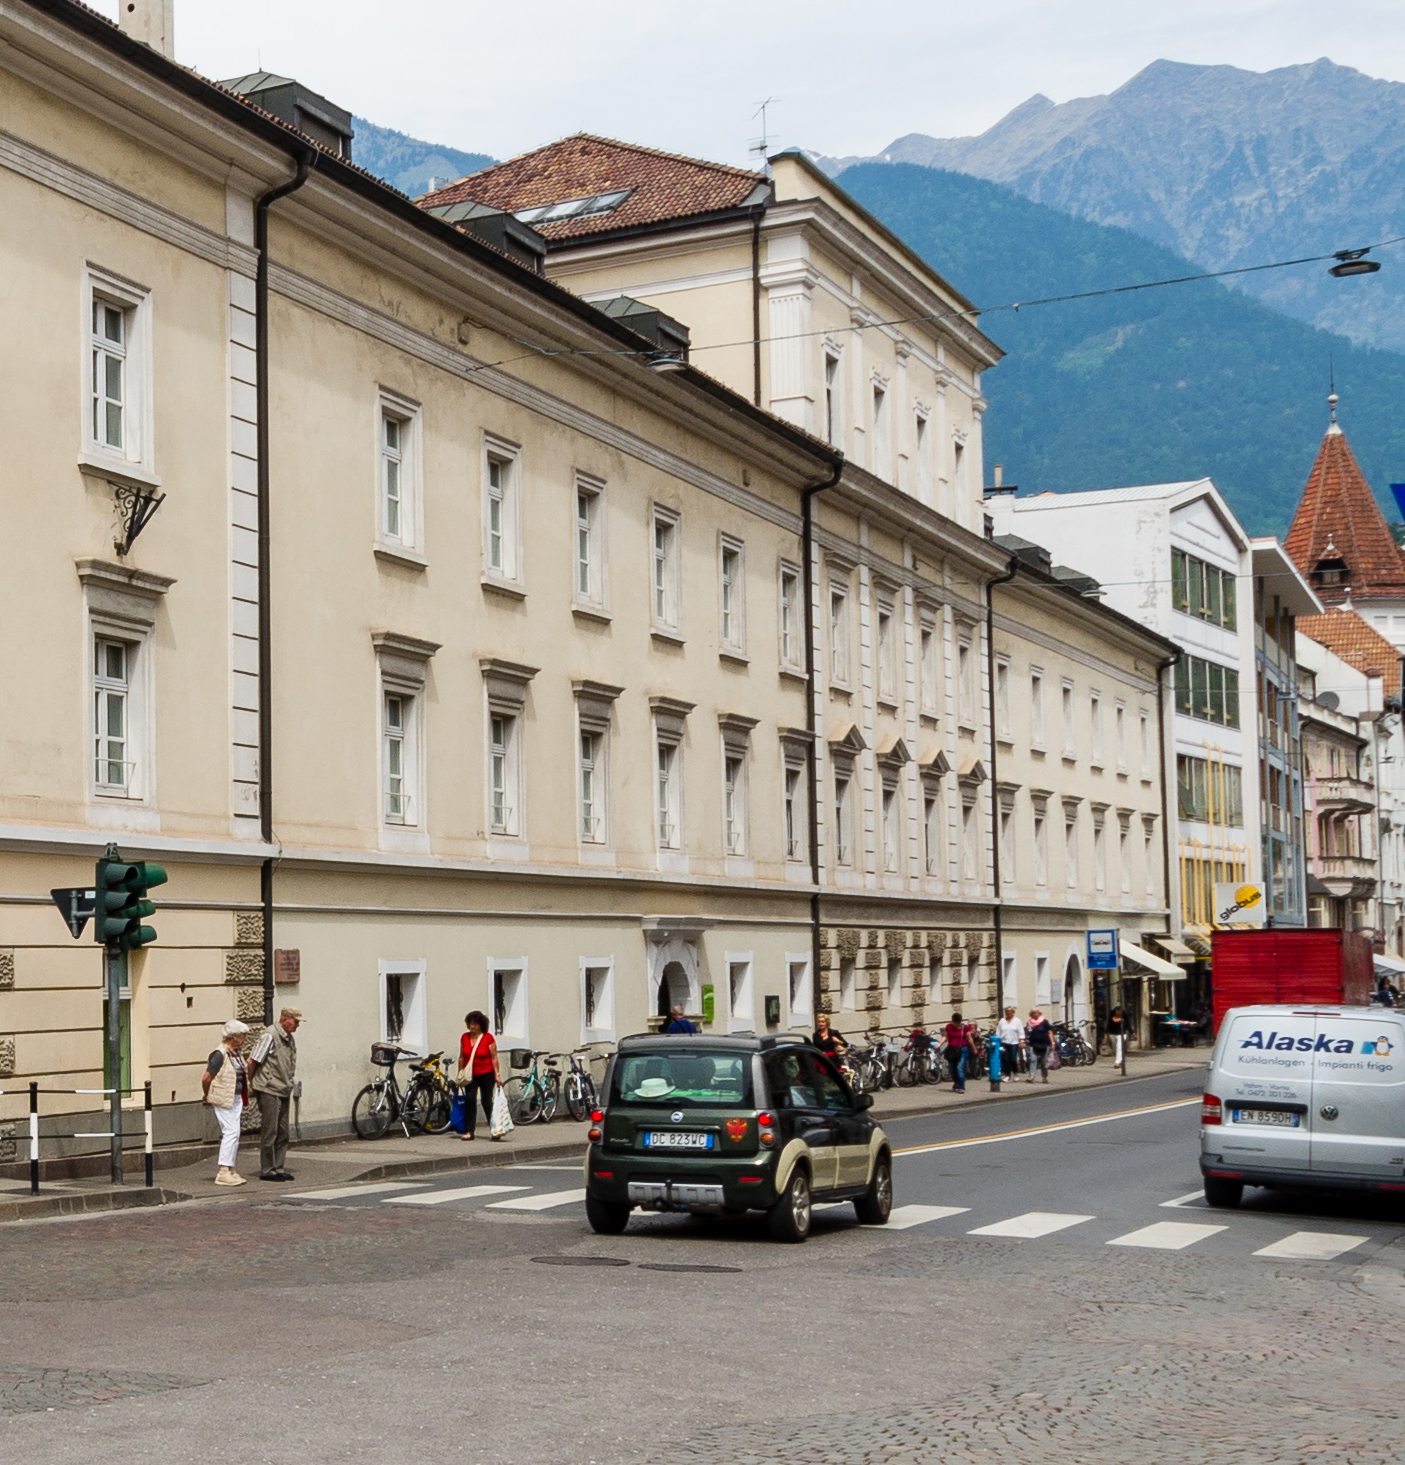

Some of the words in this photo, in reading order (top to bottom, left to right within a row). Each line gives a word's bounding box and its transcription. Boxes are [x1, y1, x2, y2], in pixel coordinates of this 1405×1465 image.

[1219, 891, 1262, 921] globus
[1240, 1030, 1354, 1054] Alaska
[1237, 1055, 1306, 1068] Kühlanlagen
[1318, 1059, 1364, 1071] Impianti
[1367, 1062, 1394, 1073] frigo
[1241, 1109, 1254, 1120] EN
[1257, 1111, 1292, 1123] 859DH
[652, 1133, 665, 1144] DC
[669, 1133, 705, 1145] 823WC
